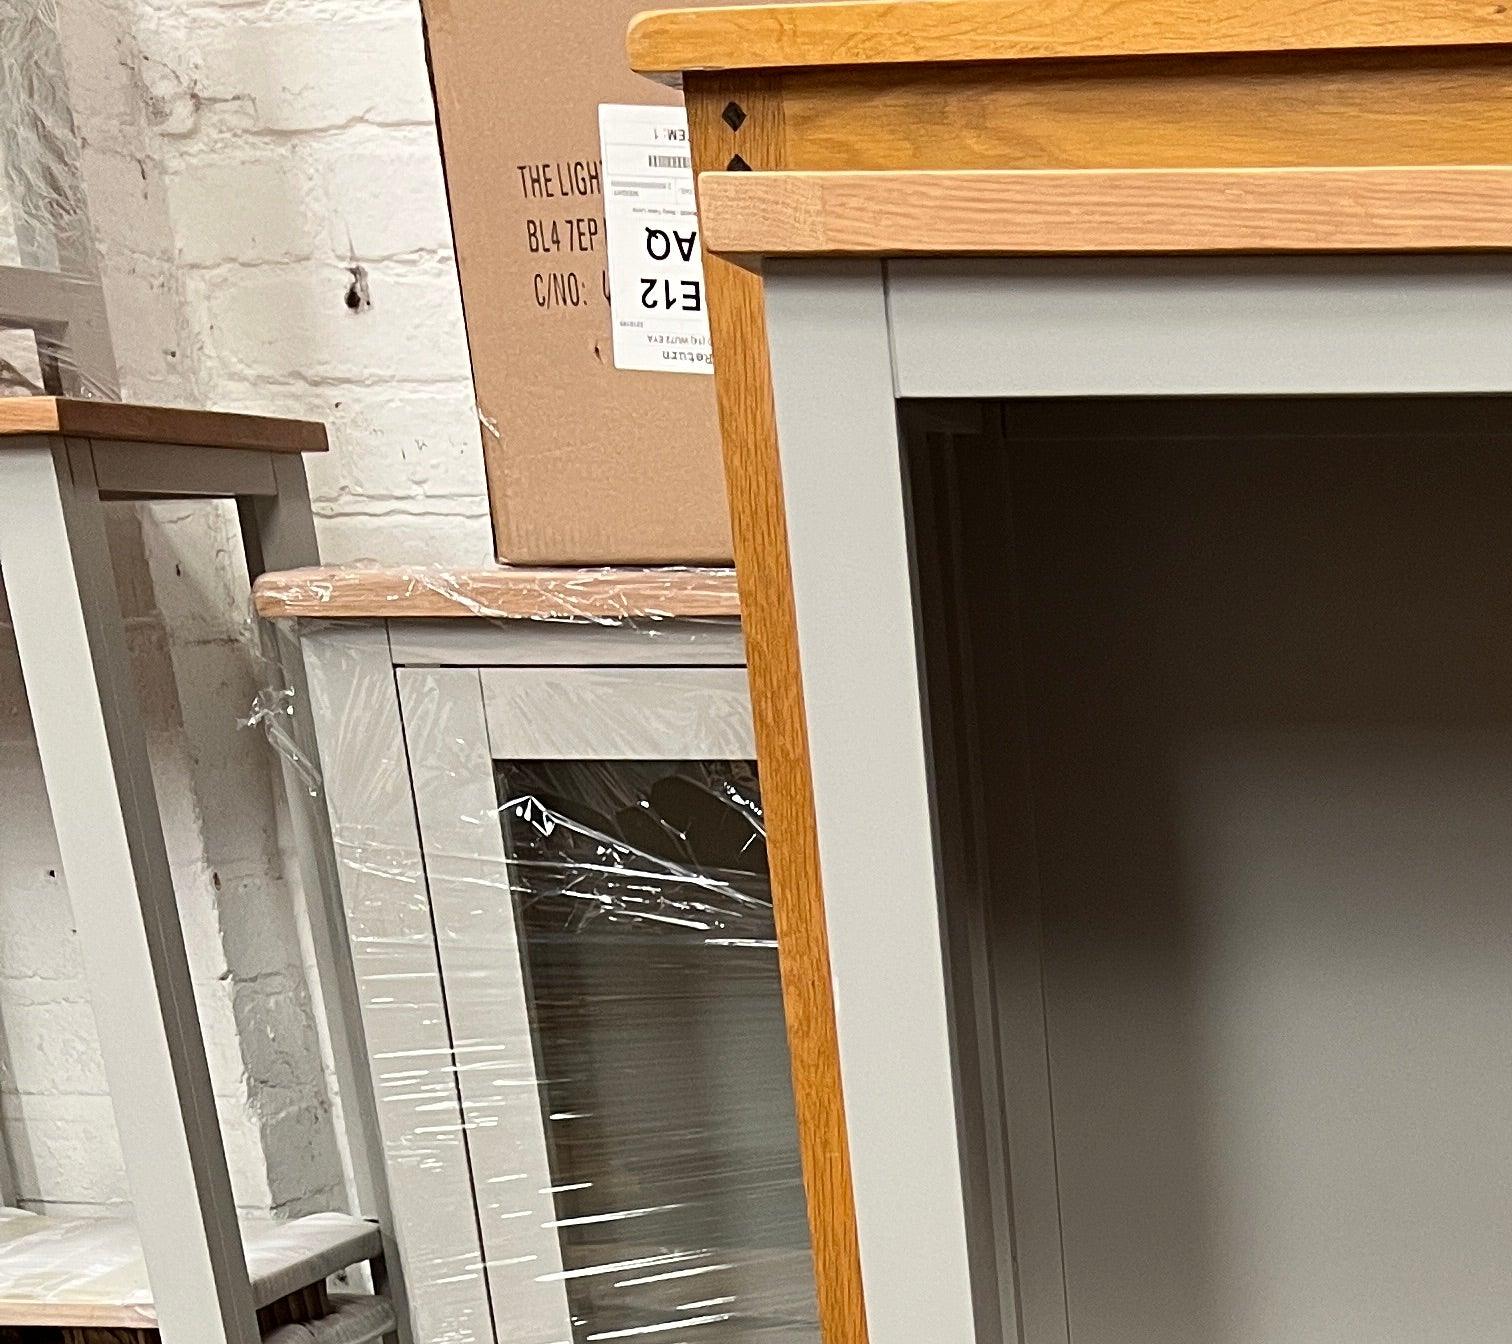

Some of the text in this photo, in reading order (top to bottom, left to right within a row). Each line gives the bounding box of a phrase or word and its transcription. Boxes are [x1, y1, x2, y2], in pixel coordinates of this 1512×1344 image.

[517, 161, 602, 198] THE LIGH
[527, 219, 560, 253] BL4
[565, 218, 598, 252] 7EP
[645, 226, 697, 262] AQ
[534, 272, 588, 309] C/NO:
[640, 278, 701, 311] E12
[662, 350, 713, 364] Return
